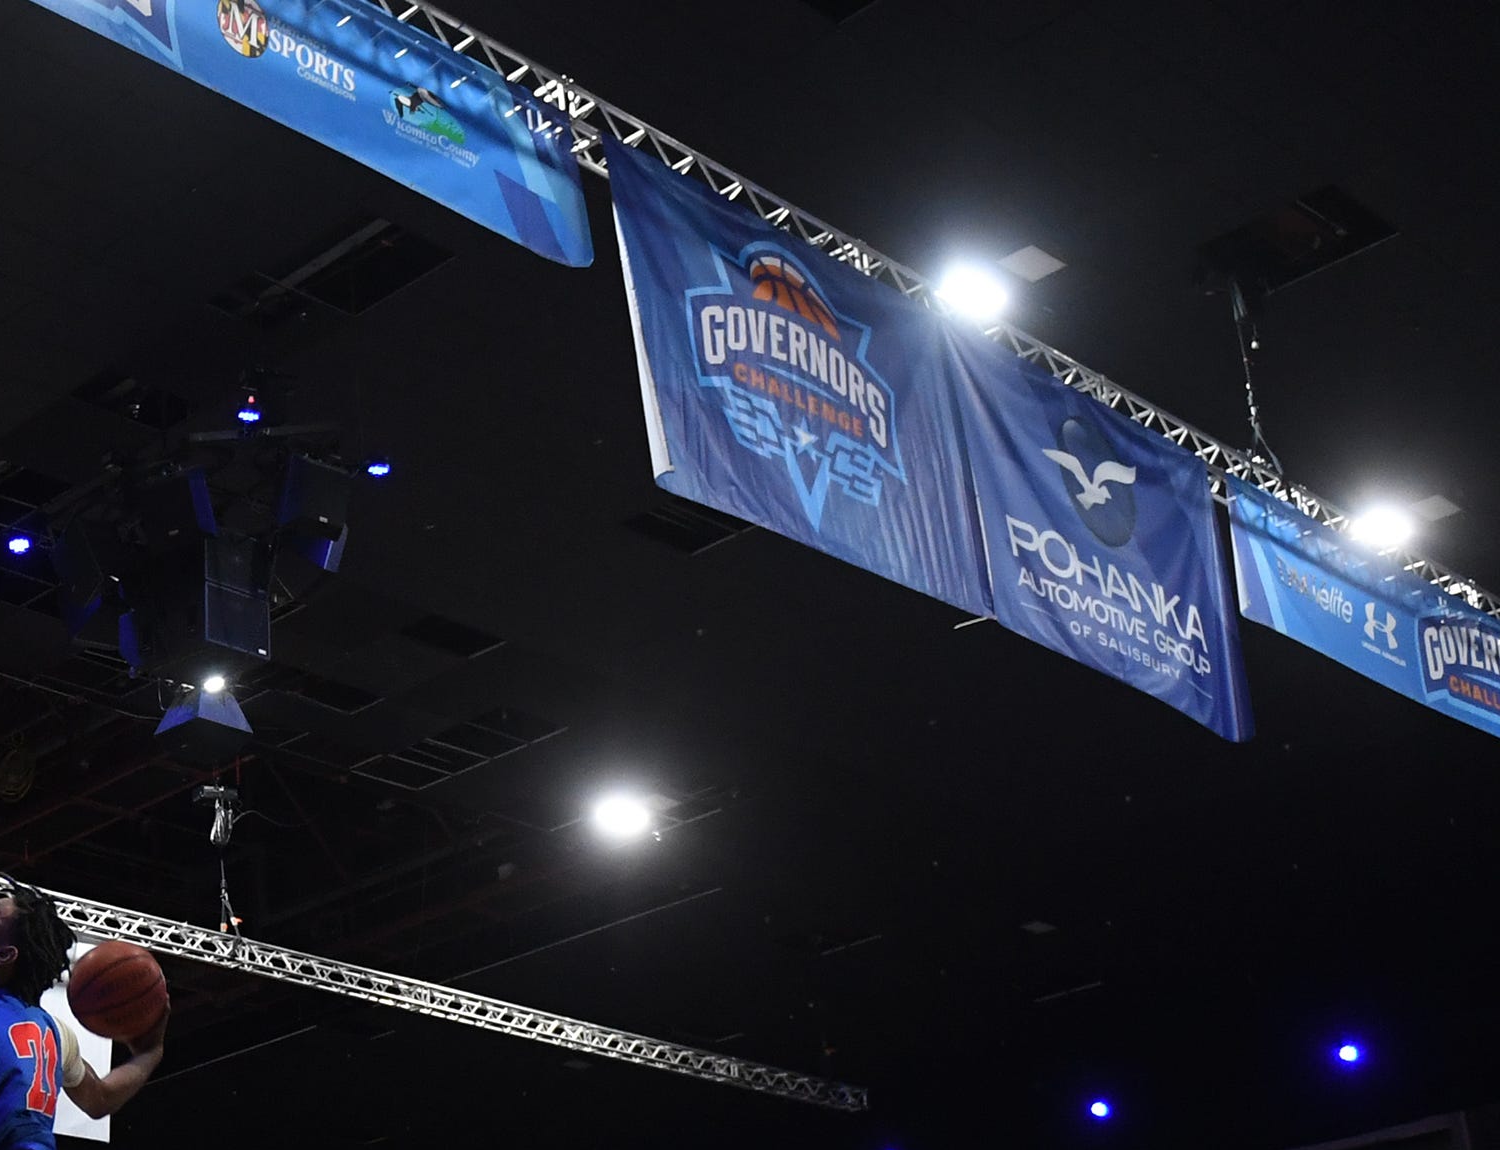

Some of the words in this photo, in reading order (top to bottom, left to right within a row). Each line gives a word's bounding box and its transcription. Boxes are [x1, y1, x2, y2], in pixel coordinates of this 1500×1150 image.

[269, 29, 355, 92] SPORTS
[701, 305, 888, 449] GOVERNORS
[733, 362, 864, 438] CHALLENGE
[1005, 514, 1208, 653] POHANKA
[1018, 567, 1149, 644] AUTOMOTIVE
[1153, 629, 1211, 676] GROUP
[1069, 620, 1092, 638] OF
[1098, 632, 1181, 679] SALISBURY
[1424, 626, 1500, 681] GOVER
[8, 1021, 58, 1119] 21
